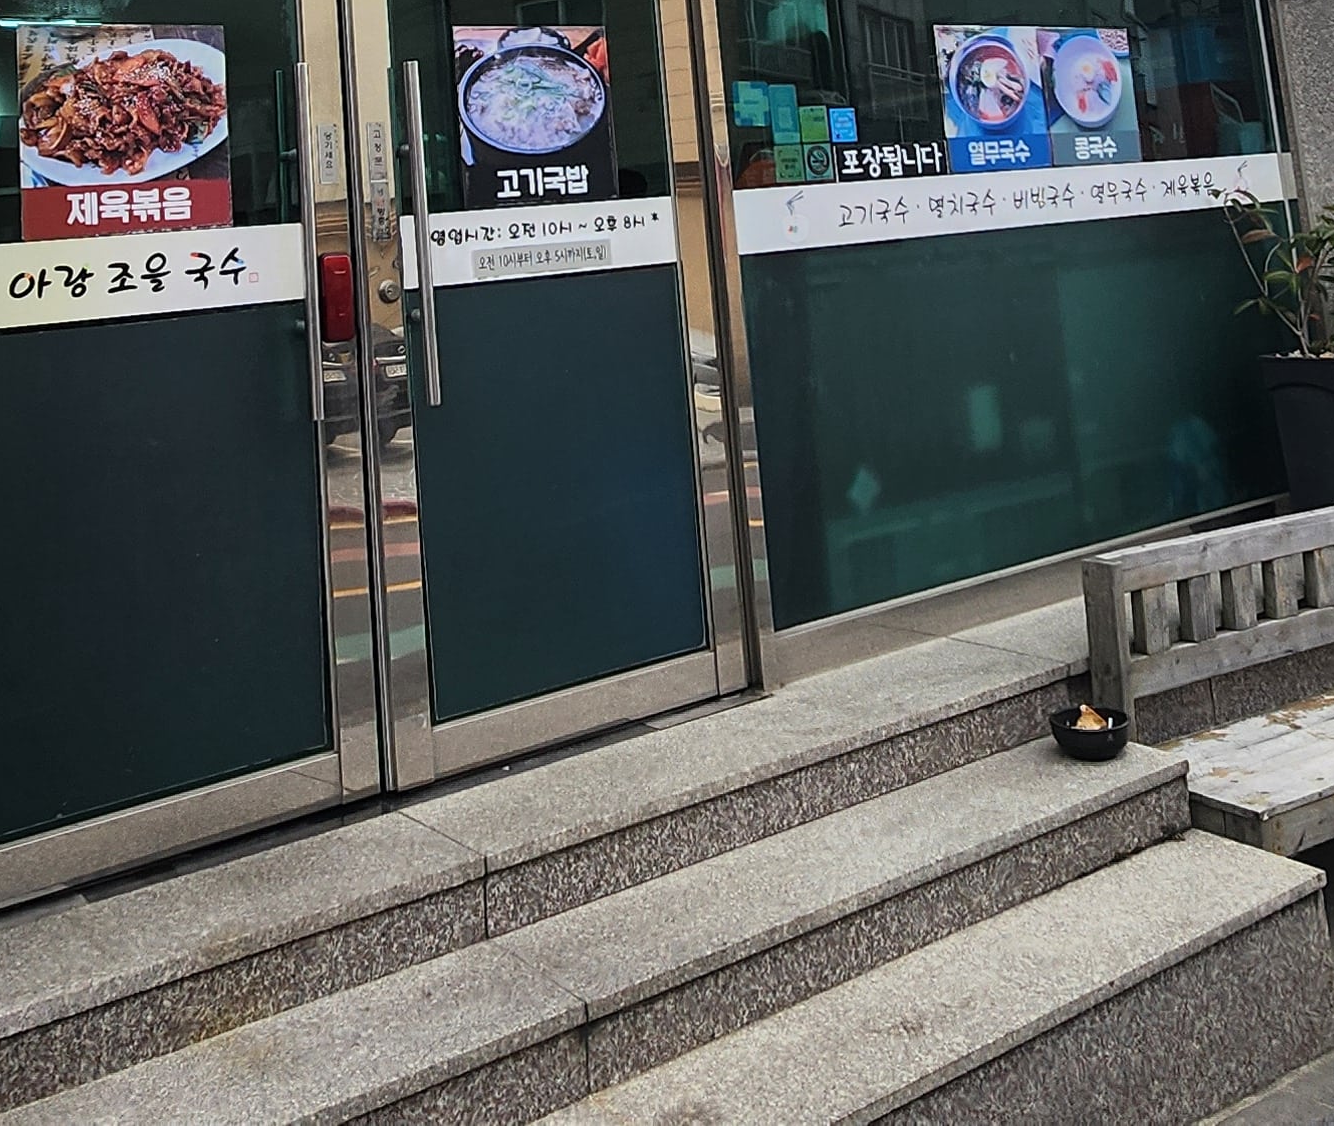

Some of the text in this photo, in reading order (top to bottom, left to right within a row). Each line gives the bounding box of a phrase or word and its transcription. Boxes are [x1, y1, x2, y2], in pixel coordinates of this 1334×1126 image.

[841, 142, 943, 178] 포장됩니다
[968, 139, 1031, 166] 열무국수
[1075, 136, 1118, 160] 콩국수
[496, 165, 589, 199] 고기국밥
[66, 186, 193, 227] 제육볶음
[838, 195, 909, 227] 고기국수
[929, 189, 996, 218] 멸치국수
[430, 225, 502, 246] 영업시간:
[508, 223, 536, 240] 오전
[542, 221, 572, 236] 10시
[594, 215, 618, 232] 오후
[623, 215, 646, 229] 8시
[9, 247, 246, 299] 아랑 조을 국수
[478, 253, 495, 271] 오전
[499, 250, 533, 268] 10시부터
[536, 249, 553, 265] 오후
